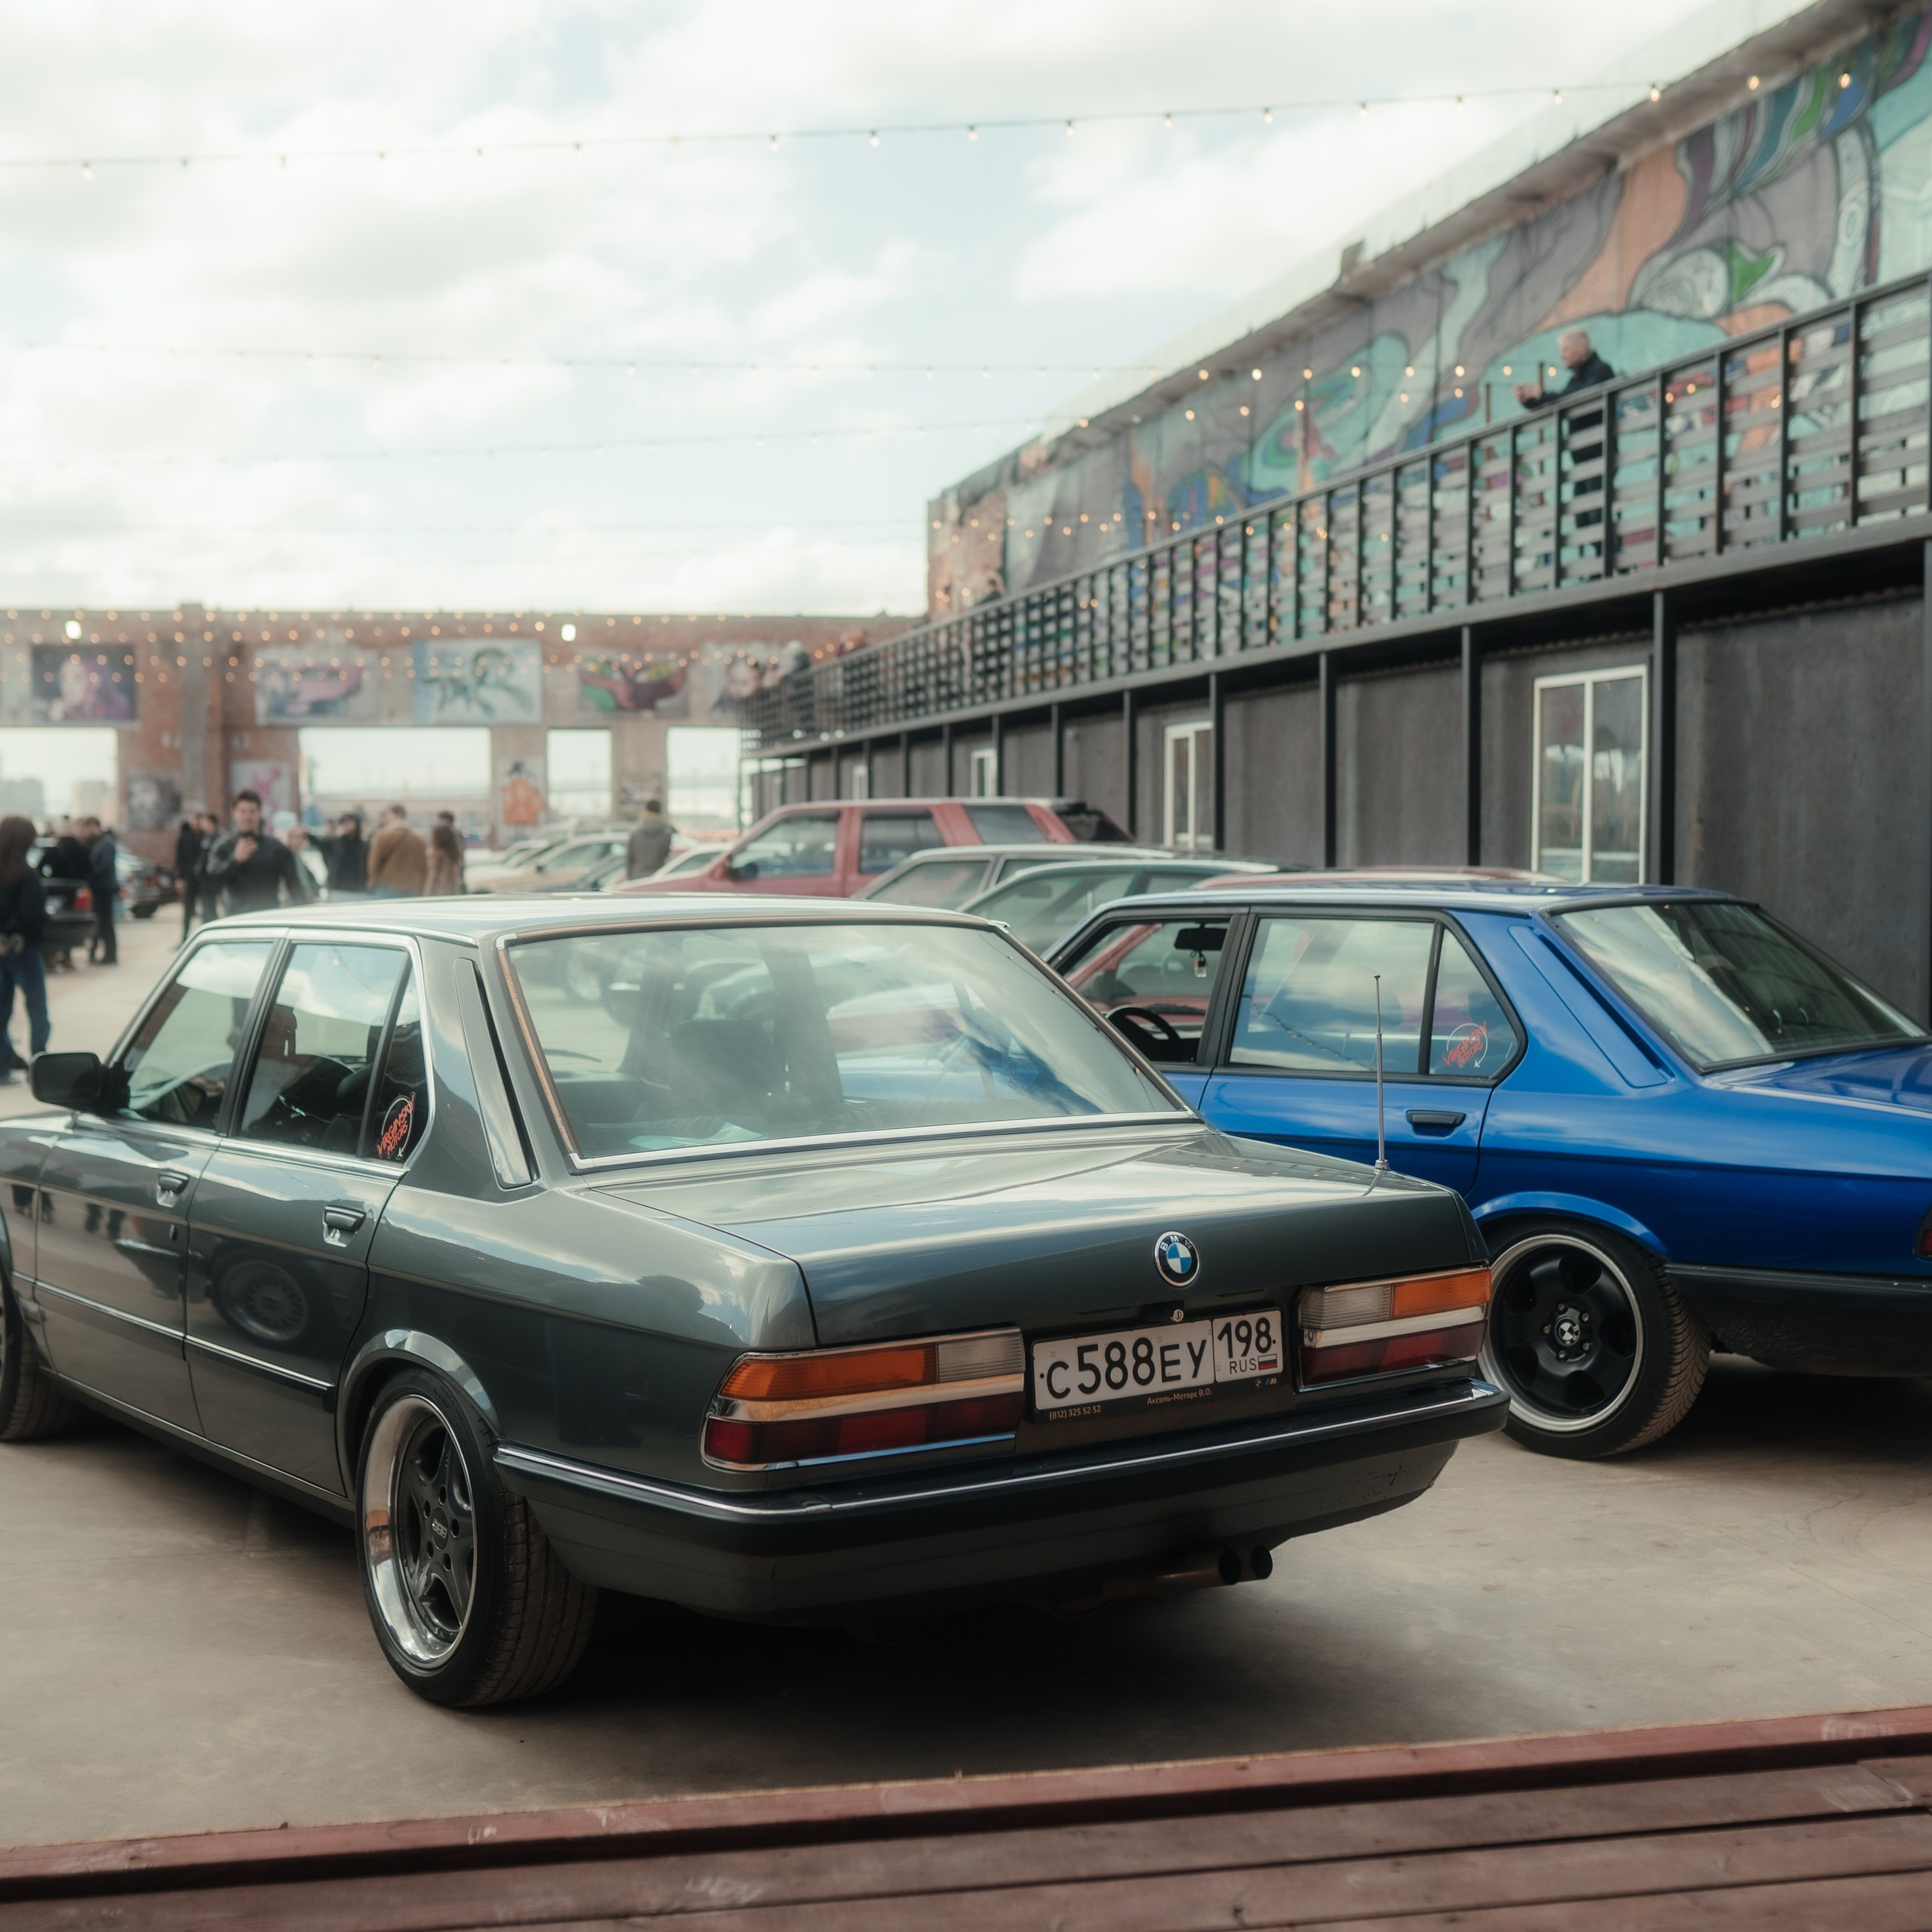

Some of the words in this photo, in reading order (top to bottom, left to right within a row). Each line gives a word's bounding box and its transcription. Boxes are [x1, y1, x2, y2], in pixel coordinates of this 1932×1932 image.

[1457, 1041, 1484, 1066] MOTORS
[386, 1120, 408, 1157] MOTORS
[1159, 1235, 1192, 1252] BMW
[1217, 1317, 1272, 1359] 198
[1229, 1358, 1257, 1375] RUS
[1146, 1392, 1198, 1405] Аксель-Моторс
[1049, 1409, 1067, 1421] (812)
[1068, 1407, 1081, 1418] 325
[1082, 1406, 1091, 1416] 52
[1092, 1404, 1102, 1414] 52
